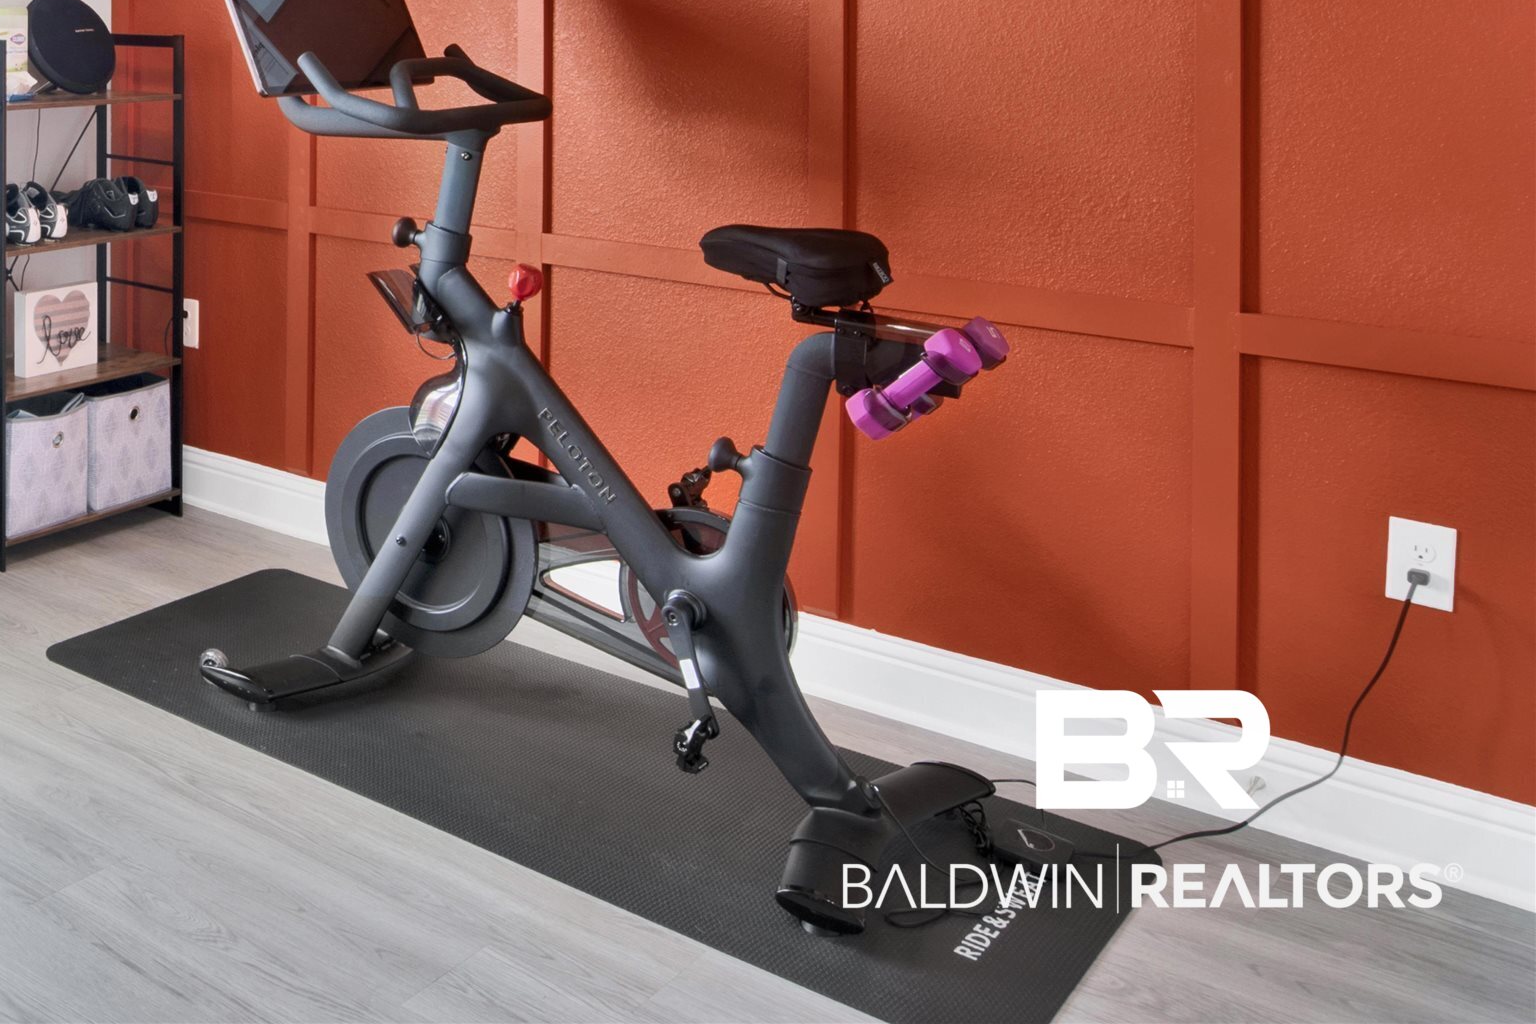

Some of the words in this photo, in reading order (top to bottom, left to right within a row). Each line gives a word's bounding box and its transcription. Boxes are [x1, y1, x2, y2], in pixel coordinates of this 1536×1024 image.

[36, 315, 91, 364] love
[537, 407, 617, 504] PELOTON
[953, 923, 1000, 961] RIDE
